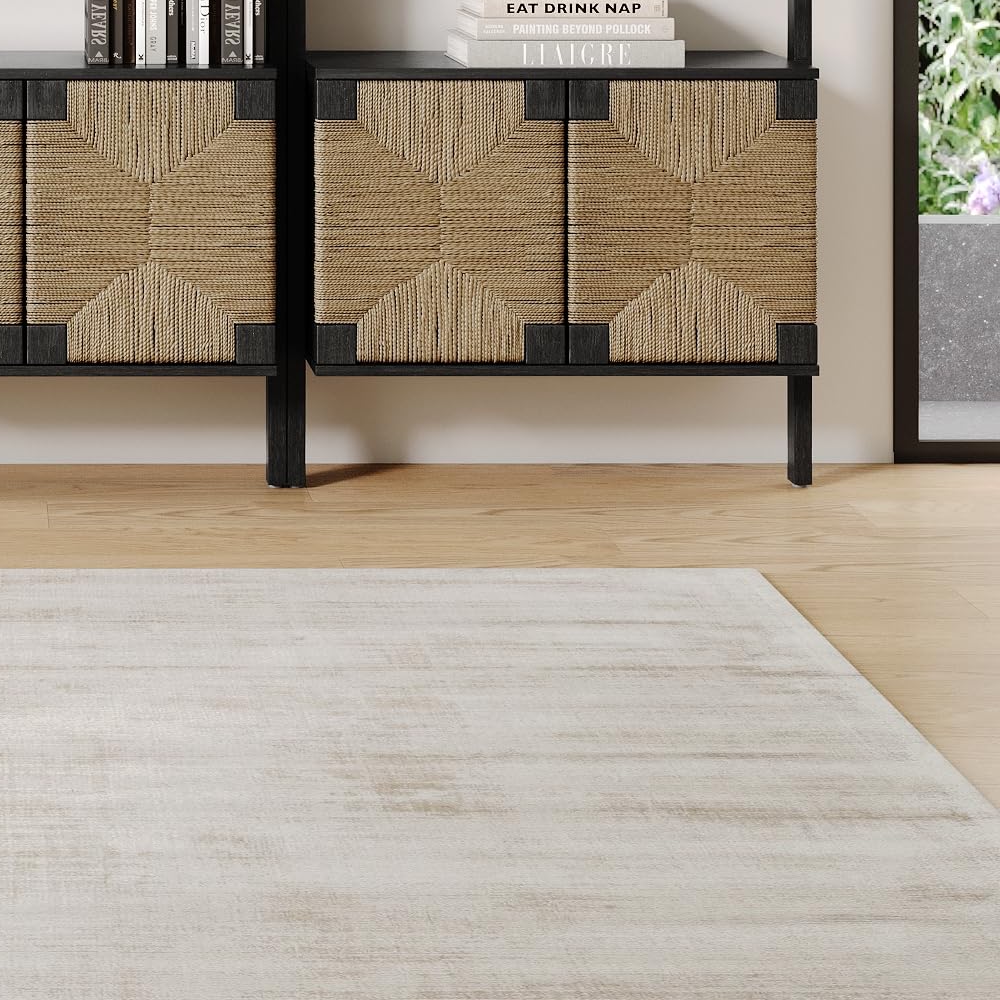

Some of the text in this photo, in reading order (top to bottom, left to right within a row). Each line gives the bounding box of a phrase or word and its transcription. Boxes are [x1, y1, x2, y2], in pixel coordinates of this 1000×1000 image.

[506, 3, 641, 14] EAT DRINK NAP
[201, 5, 209, 34] Dior
[512, 24, 559, 34] PAINTING
[562, 24, 602, 34] BEYOND
[605, 24, 651, 34] POLLOCK
[522, 43, 632, 65] LIAIGRE
